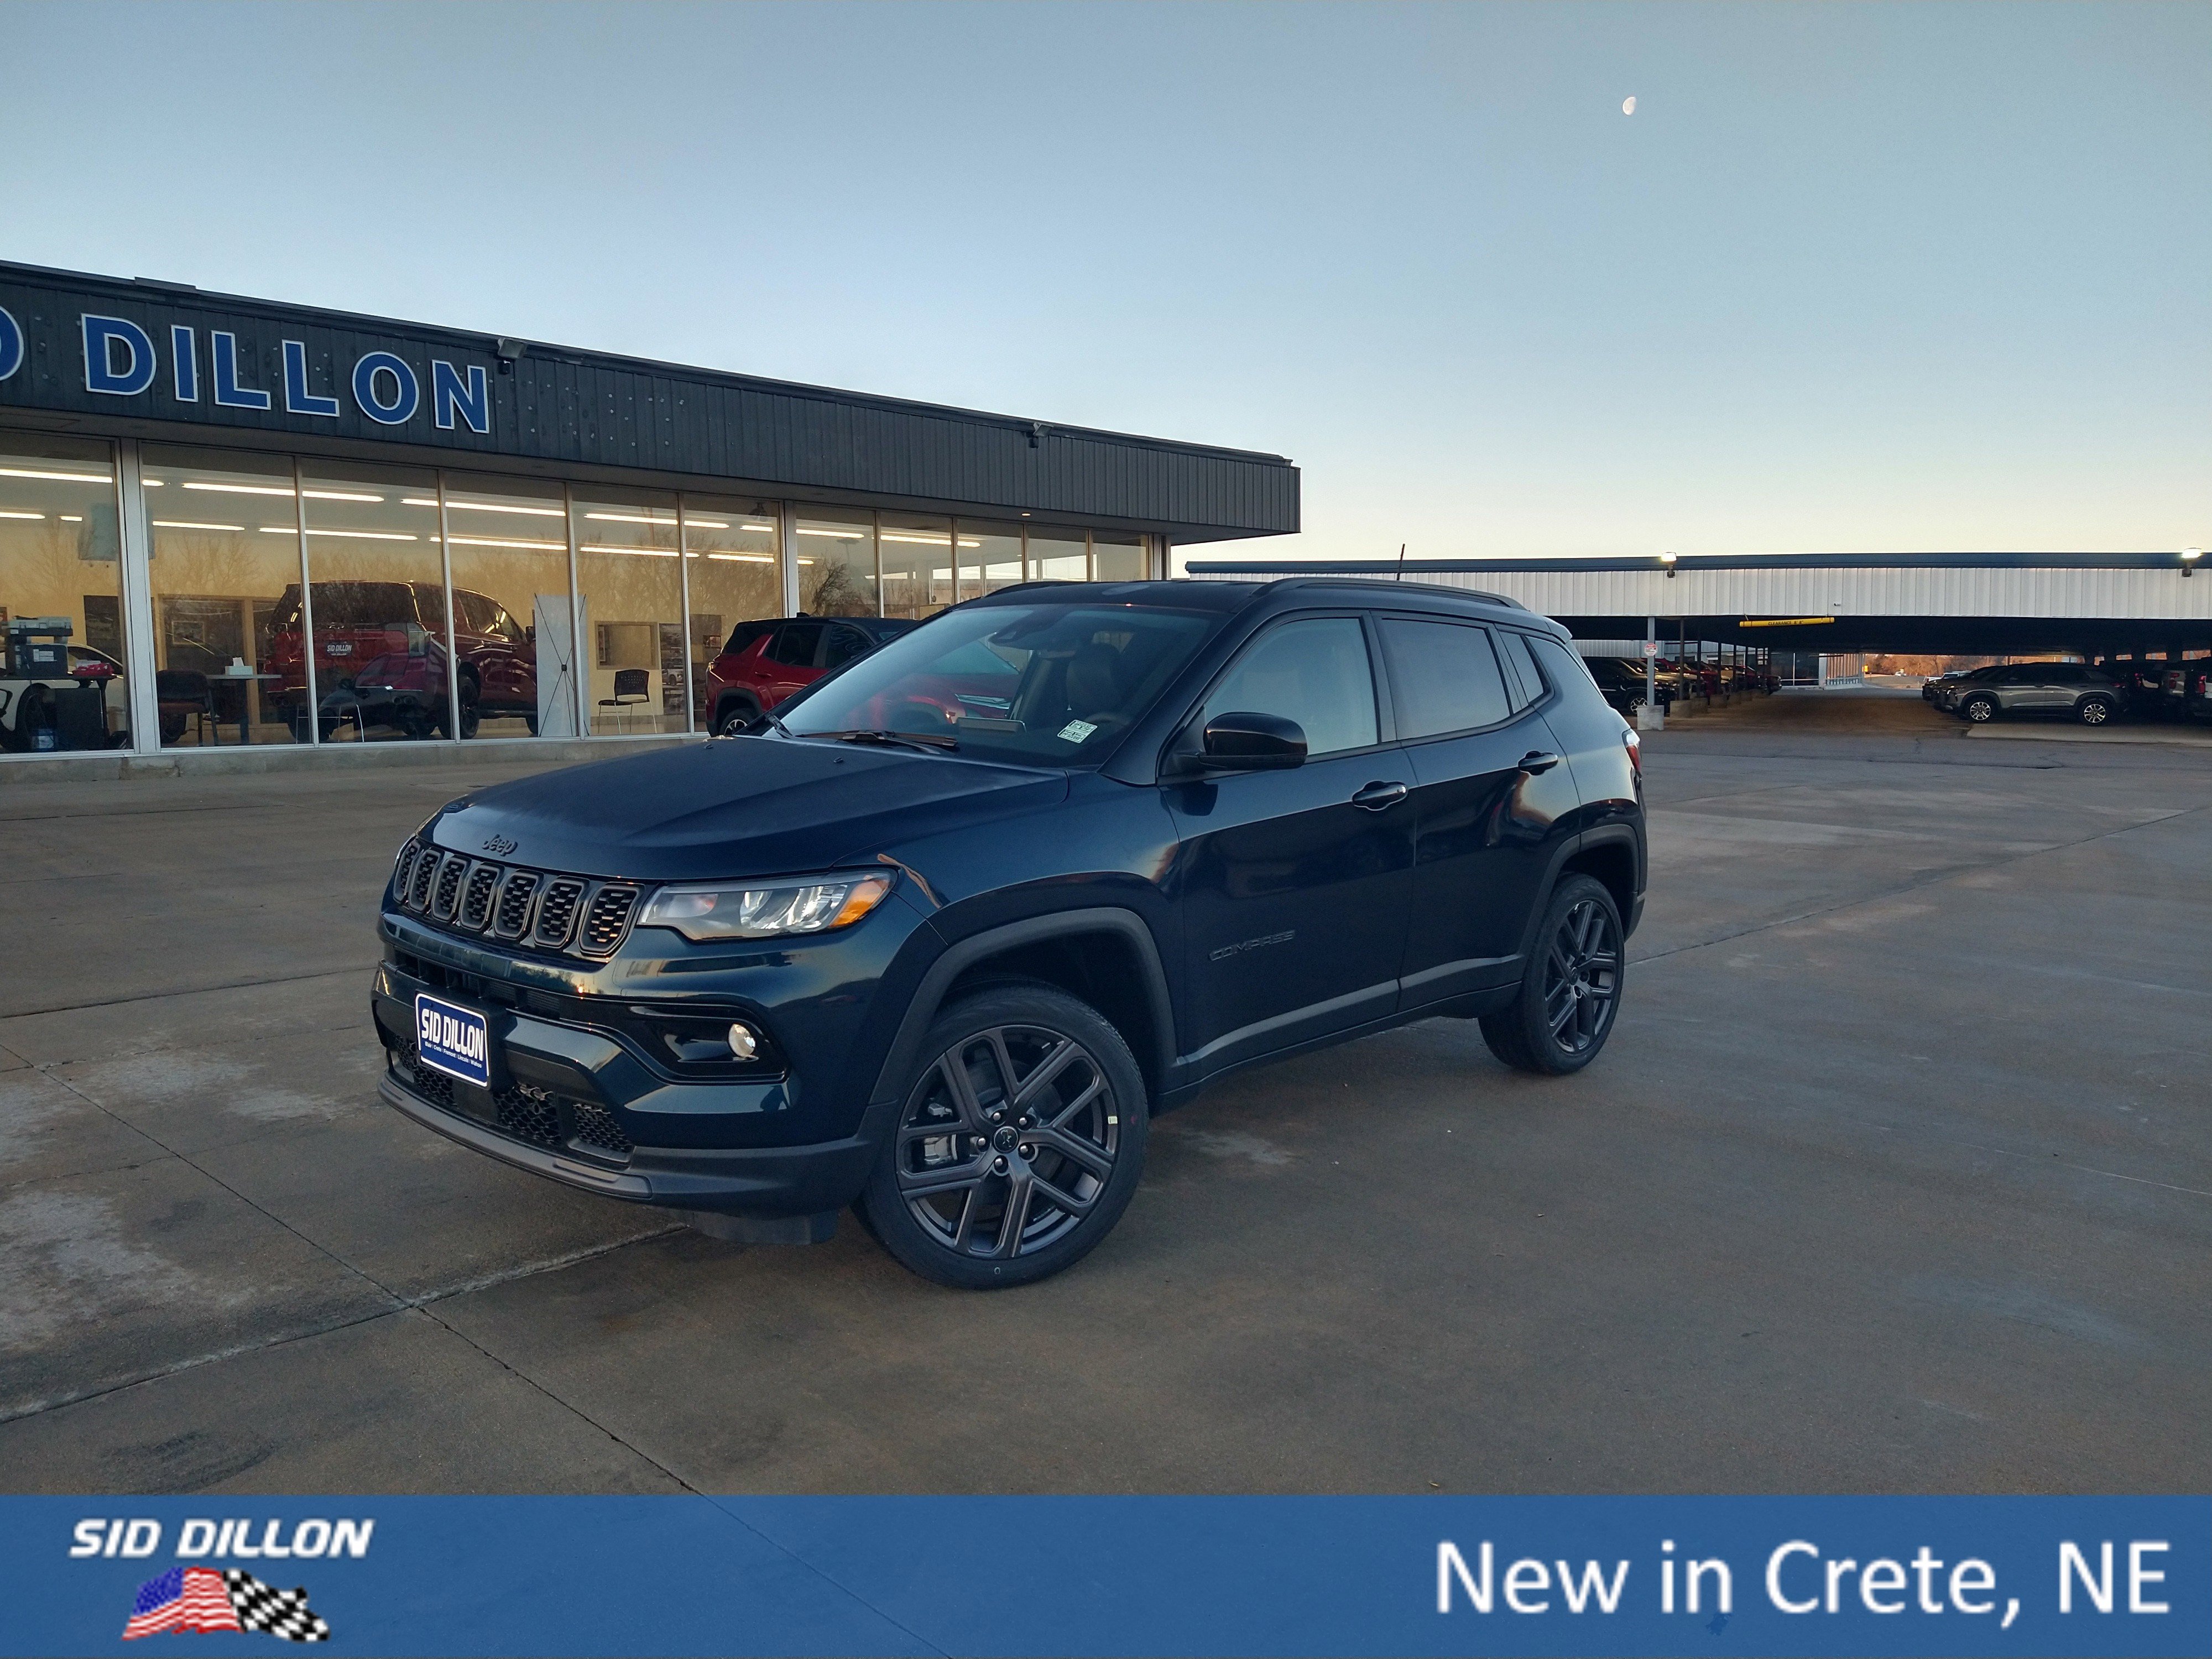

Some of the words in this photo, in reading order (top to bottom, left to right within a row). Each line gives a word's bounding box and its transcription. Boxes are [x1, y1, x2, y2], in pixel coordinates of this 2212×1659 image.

[81, 312, 490, 434] DILLON
[482, 834, 518, 857] Jeep
[1209, 930, 1296, 961] COMPASS
[421, 1008, 441, 1044] SID
[442, 1015, 483, 1061] DILLON
[443, 1048, 456, 1058] Fremont
[457, 1054, 469, 1063] Lincoln
[471, 1059, 482, 1068] Wahoo
